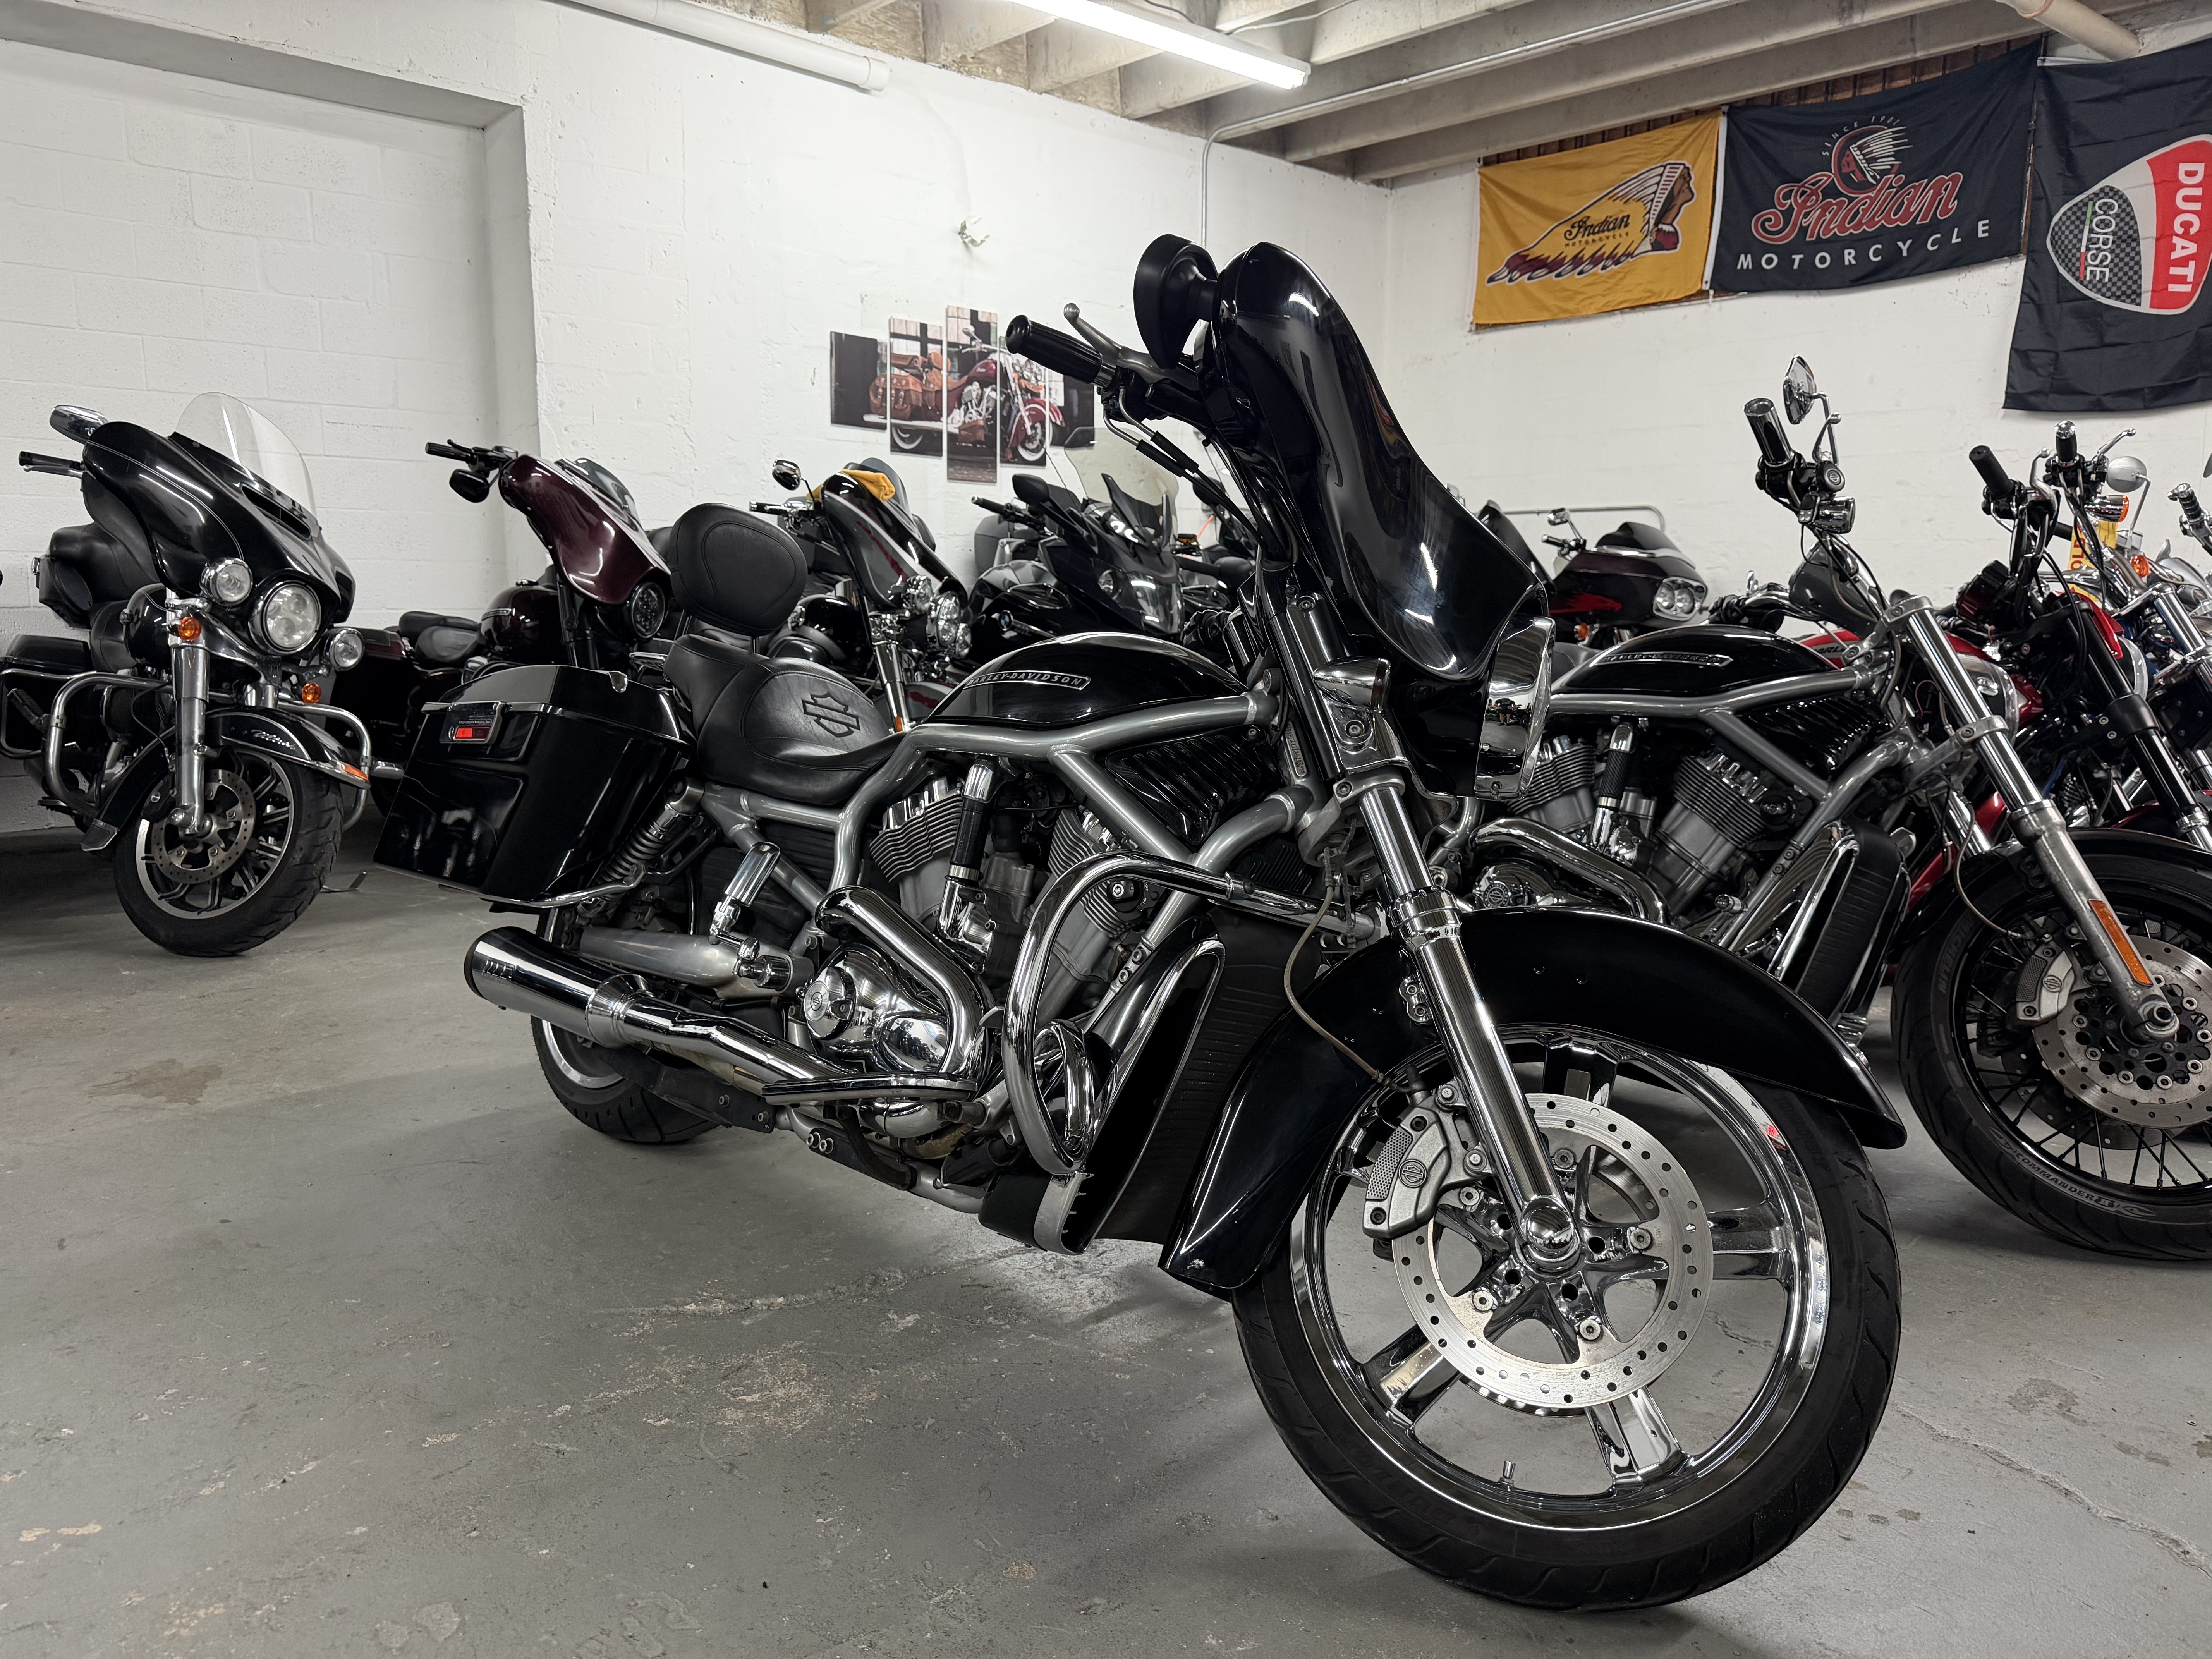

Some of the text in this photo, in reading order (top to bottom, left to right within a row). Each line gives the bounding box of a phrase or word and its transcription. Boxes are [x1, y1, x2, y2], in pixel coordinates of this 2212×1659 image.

[1822, 115, 1900, 156] SINCE 1901
[1564, 214, 1630, 241] Indian
[1752, 172, 1963, 244] Indian
[2168, 163, 2205, 292] DUCATI
[1565, 232, 1629, 247] MOTORCYCLE
[1737, 220, 1989, 270] MOTORCYCLE
[2086, 198, 2118, 282] CORSE
[968, 672, 1082, 685] HARLEY-DAVIDSON
[2016, 1153, 2094, 1201] COMMANDER
